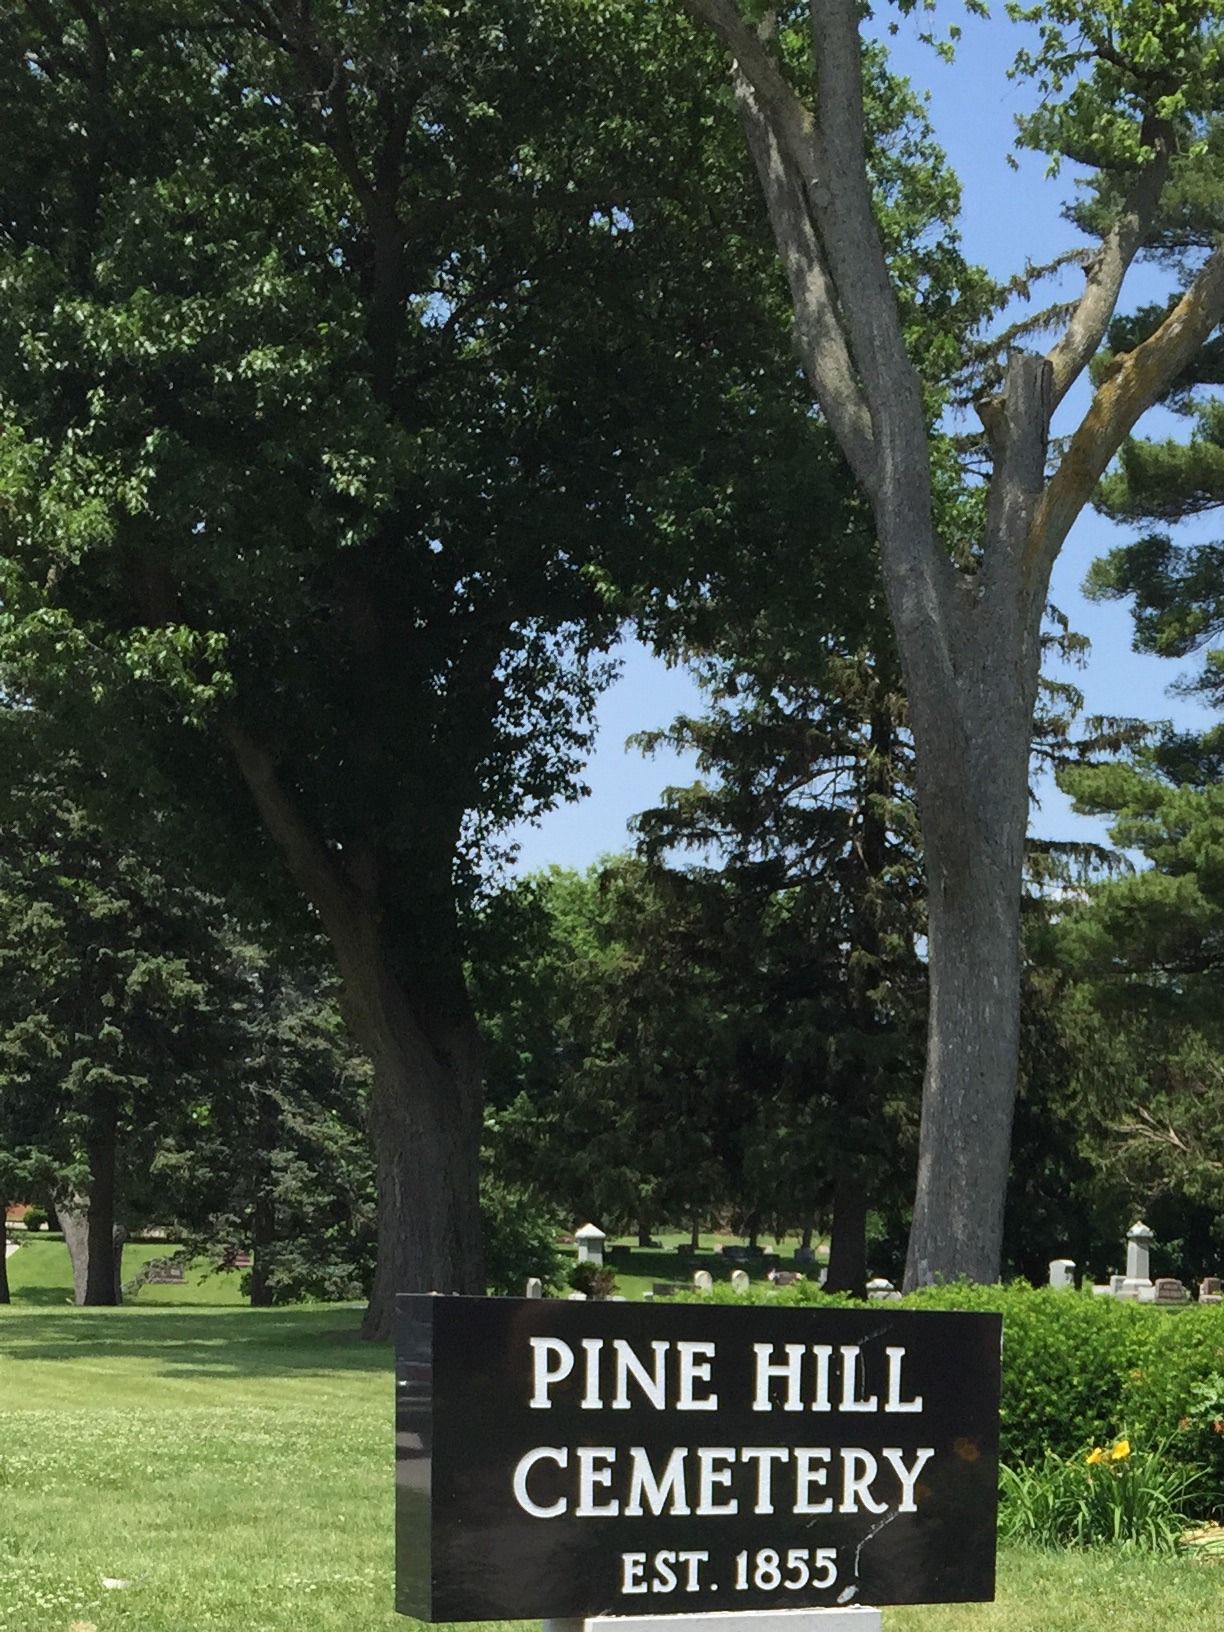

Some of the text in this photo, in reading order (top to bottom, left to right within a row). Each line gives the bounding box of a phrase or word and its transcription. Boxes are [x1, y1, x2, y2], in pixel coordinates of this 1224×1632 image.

[529, 1337, 923, 1413] PINE HILL
[513, 1446, 935, 1518] CEMETERY
[621, 1548, 838, 1594] EST. 1855
